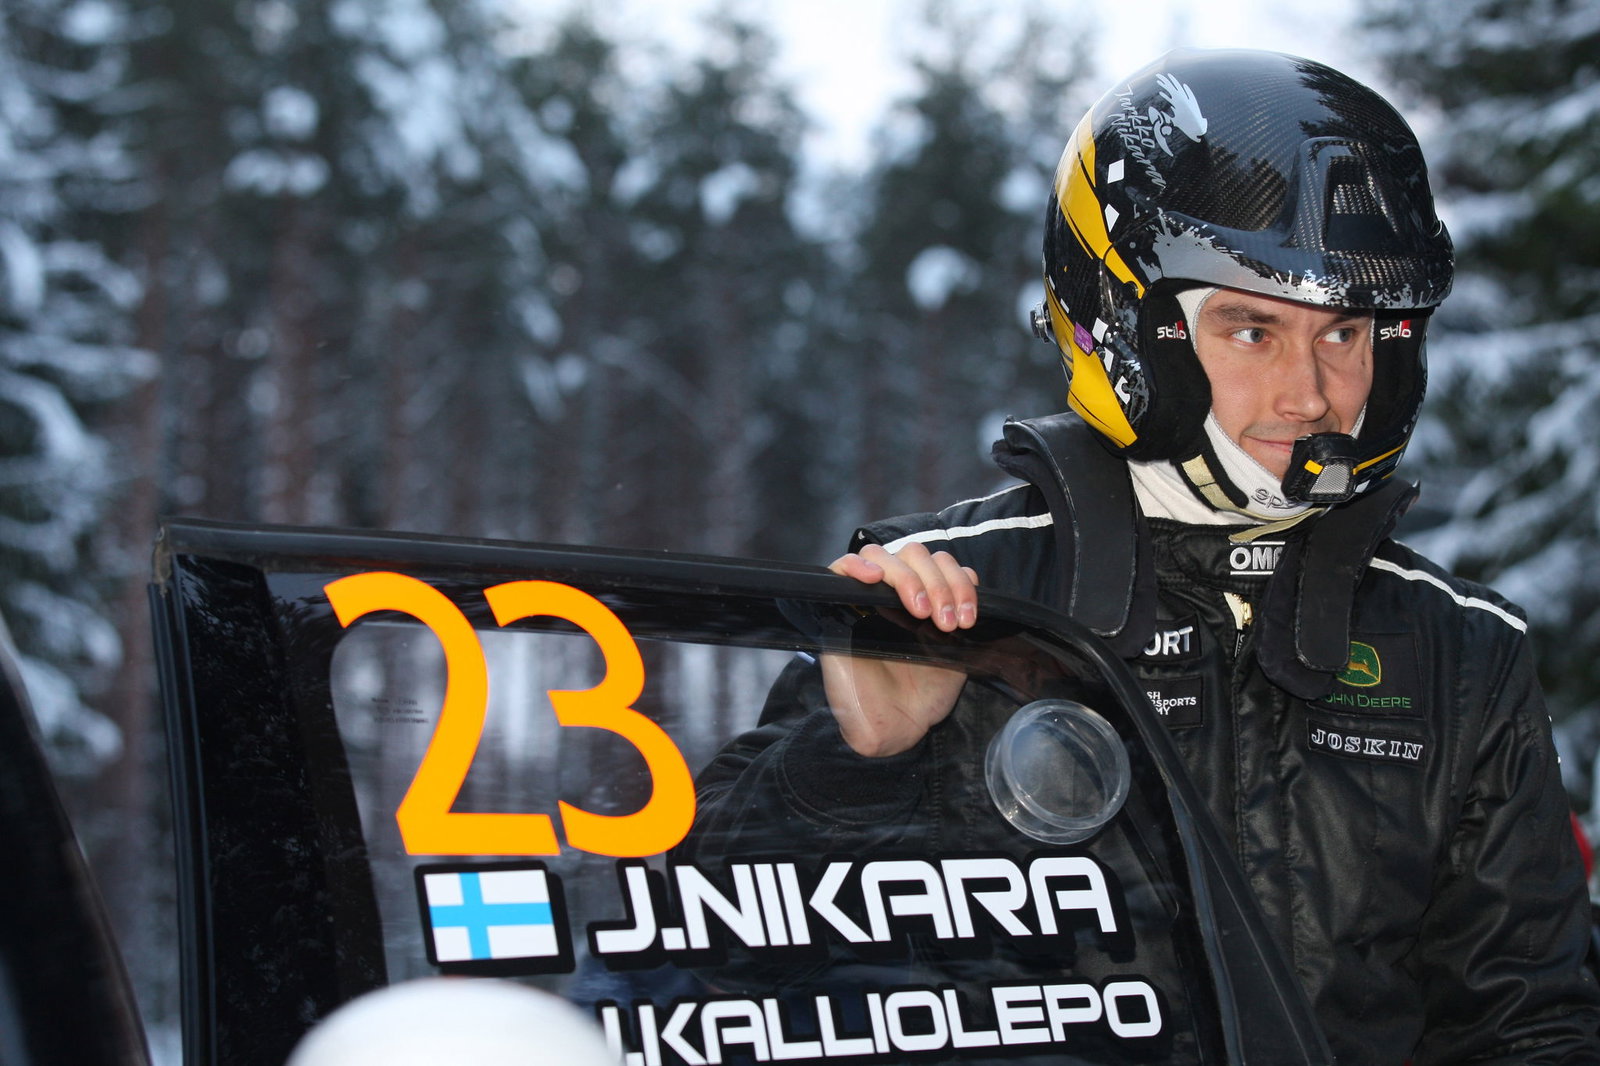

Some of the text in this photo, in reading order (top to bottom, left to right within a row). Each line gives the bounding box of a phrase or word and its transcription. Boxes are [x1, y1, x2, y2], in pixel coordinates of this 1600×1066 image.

[1108, 113, 1167, 190] Nikara
[1156, 320, 1187, 340] stilo
[1380, 320, 1412, 340] stilo
[1142, 625, 1194, 656] ORT
[1151, 696, 1197, 708] SPORTS
[1155, 706, 1171, 716] MY
[1319, 692, 1413, 709] OHN DEERE
[324, 571, 696, 858] 23
[1311, 728, 1424, 761] JOSKIN
[595, 857, 1118, 954] J.NIKARA
